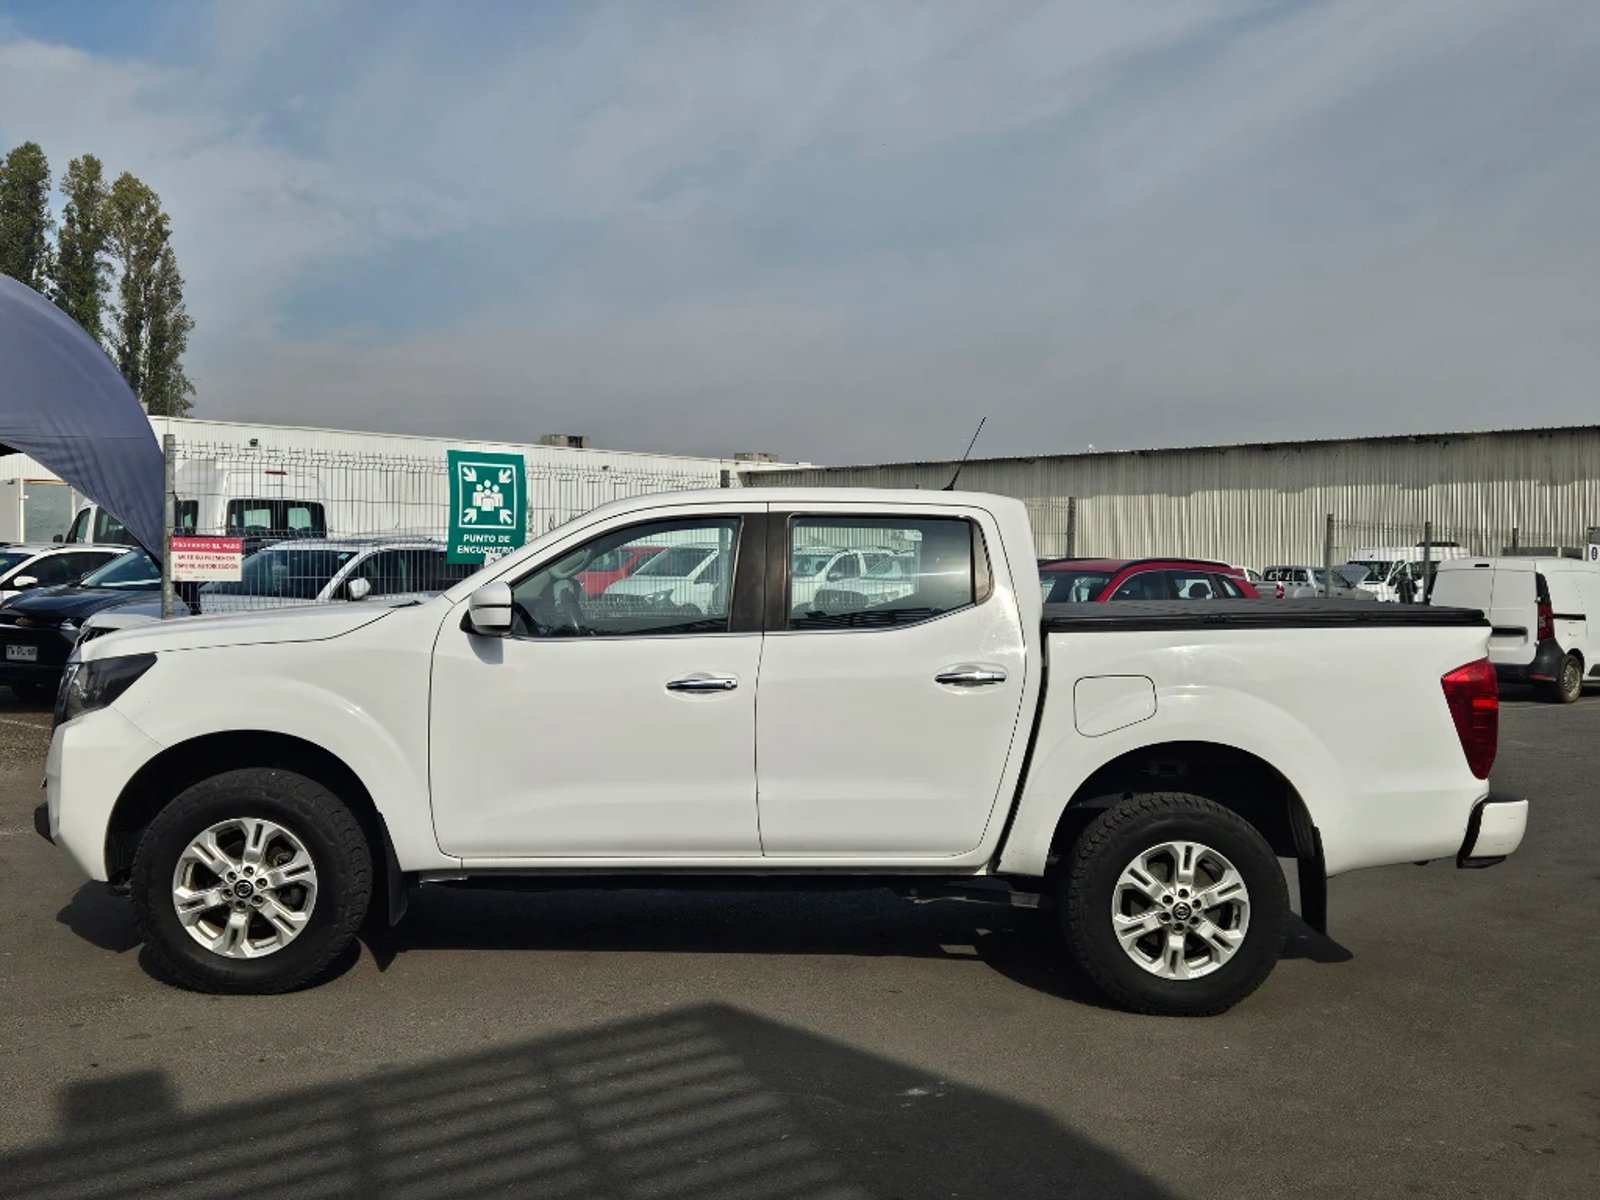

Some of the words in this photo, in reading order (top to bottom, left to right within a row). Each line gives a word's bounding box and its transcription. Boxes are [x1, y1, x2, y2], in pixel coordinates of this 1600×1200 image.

[463, 533, 496, 543] PUNTO
[498, 535, 511, 543] DE
[457, 544, 515, 554] ENCUENTRO
